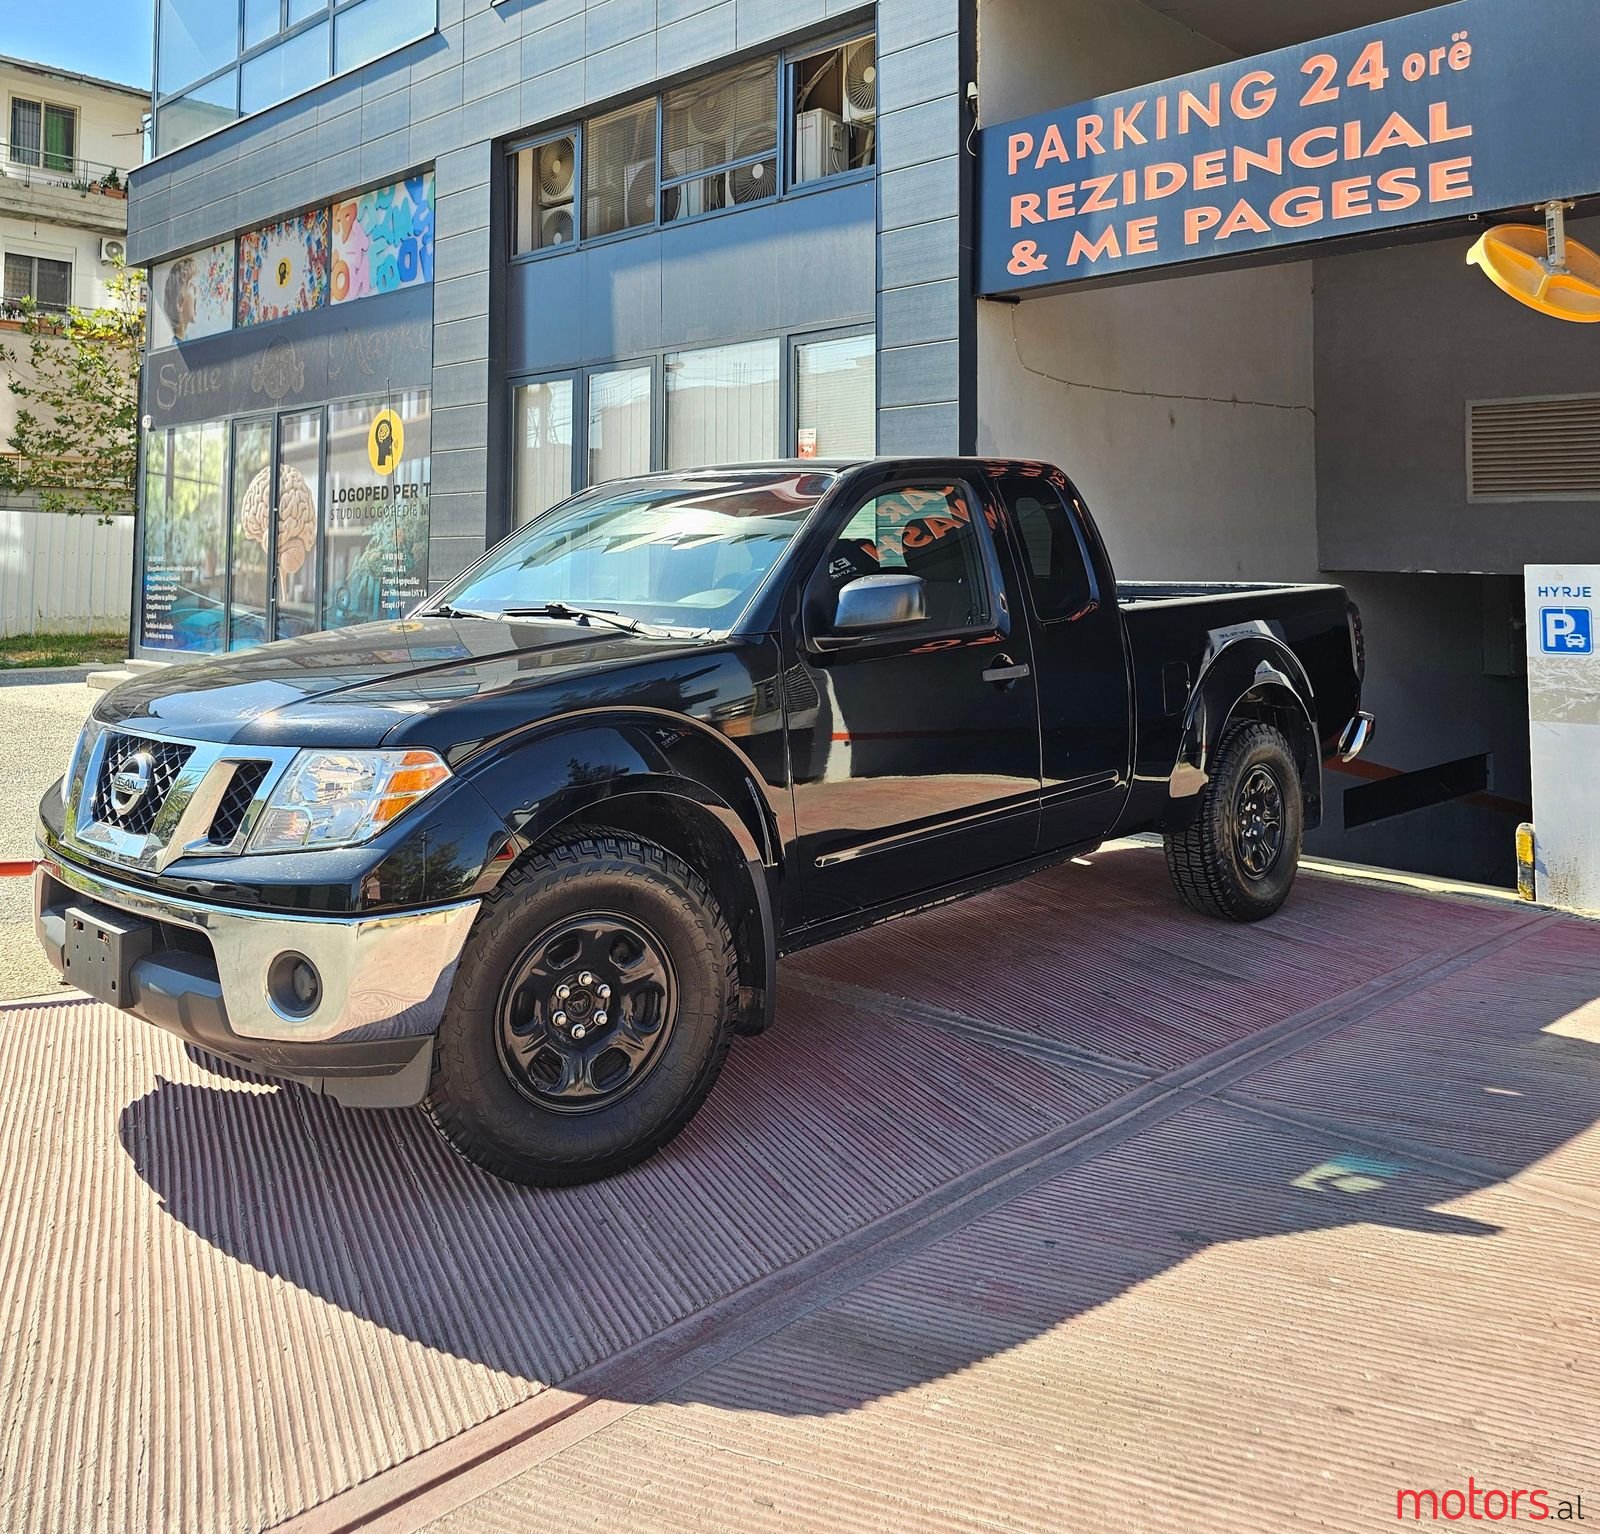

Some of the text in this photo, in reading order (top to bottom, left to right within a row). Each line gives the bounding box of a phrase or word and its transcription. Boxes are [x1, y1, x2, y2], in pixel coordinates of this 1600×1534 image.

[1008, 31, 1472, 175] PARKING 24 orë
[1010, 102, 1473, 229] REZIDENCIAL
[1006, 156, 1474, 276] & ME PAGESE
[330, 507, 362, 521] STUDIO
[332, 485, 389, 504] LOGOPED
[393, 483, 419, 500] PER
[1538, 586, 1592, 598] HYRJE
